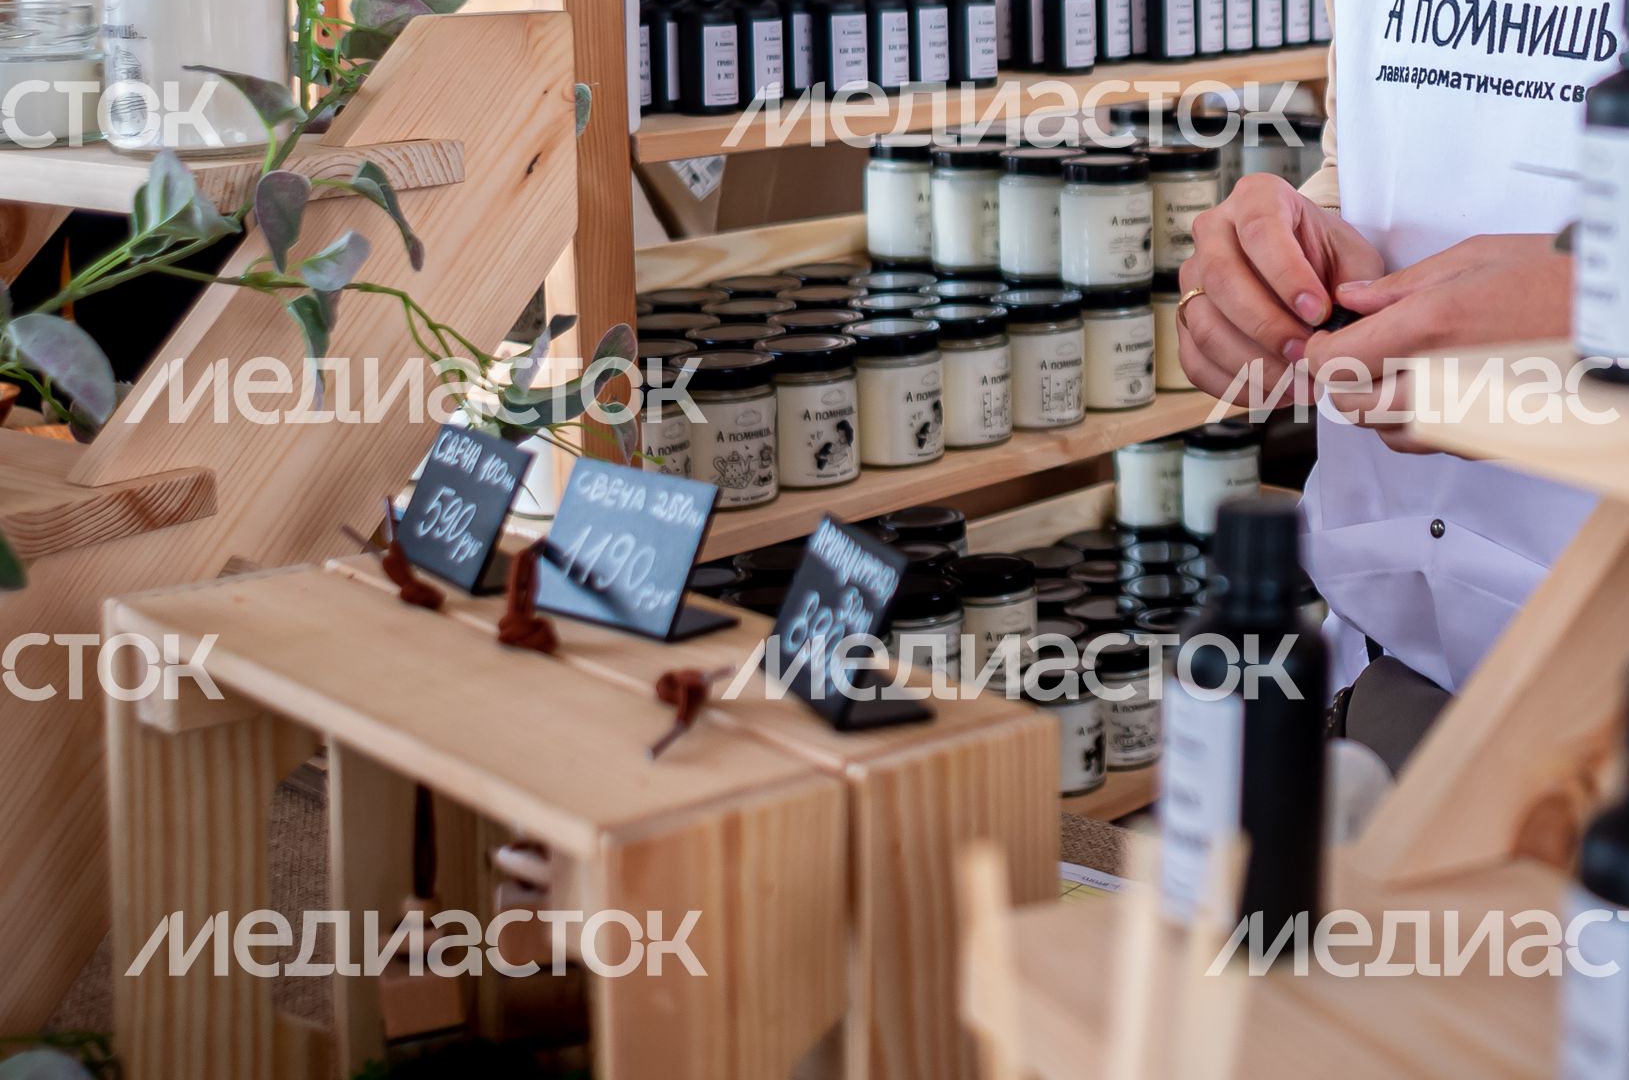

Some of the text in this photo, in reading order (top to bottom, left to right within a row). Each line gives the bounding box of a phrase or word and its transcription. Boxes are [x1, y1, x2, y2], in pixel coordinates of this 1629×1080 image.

[1375, 63, 1410, 83] лавка
[1411, 66, 1555, 101] ароматических
[417, 485, 478, 543] 590
[562, 524, 657, 591] 1190
